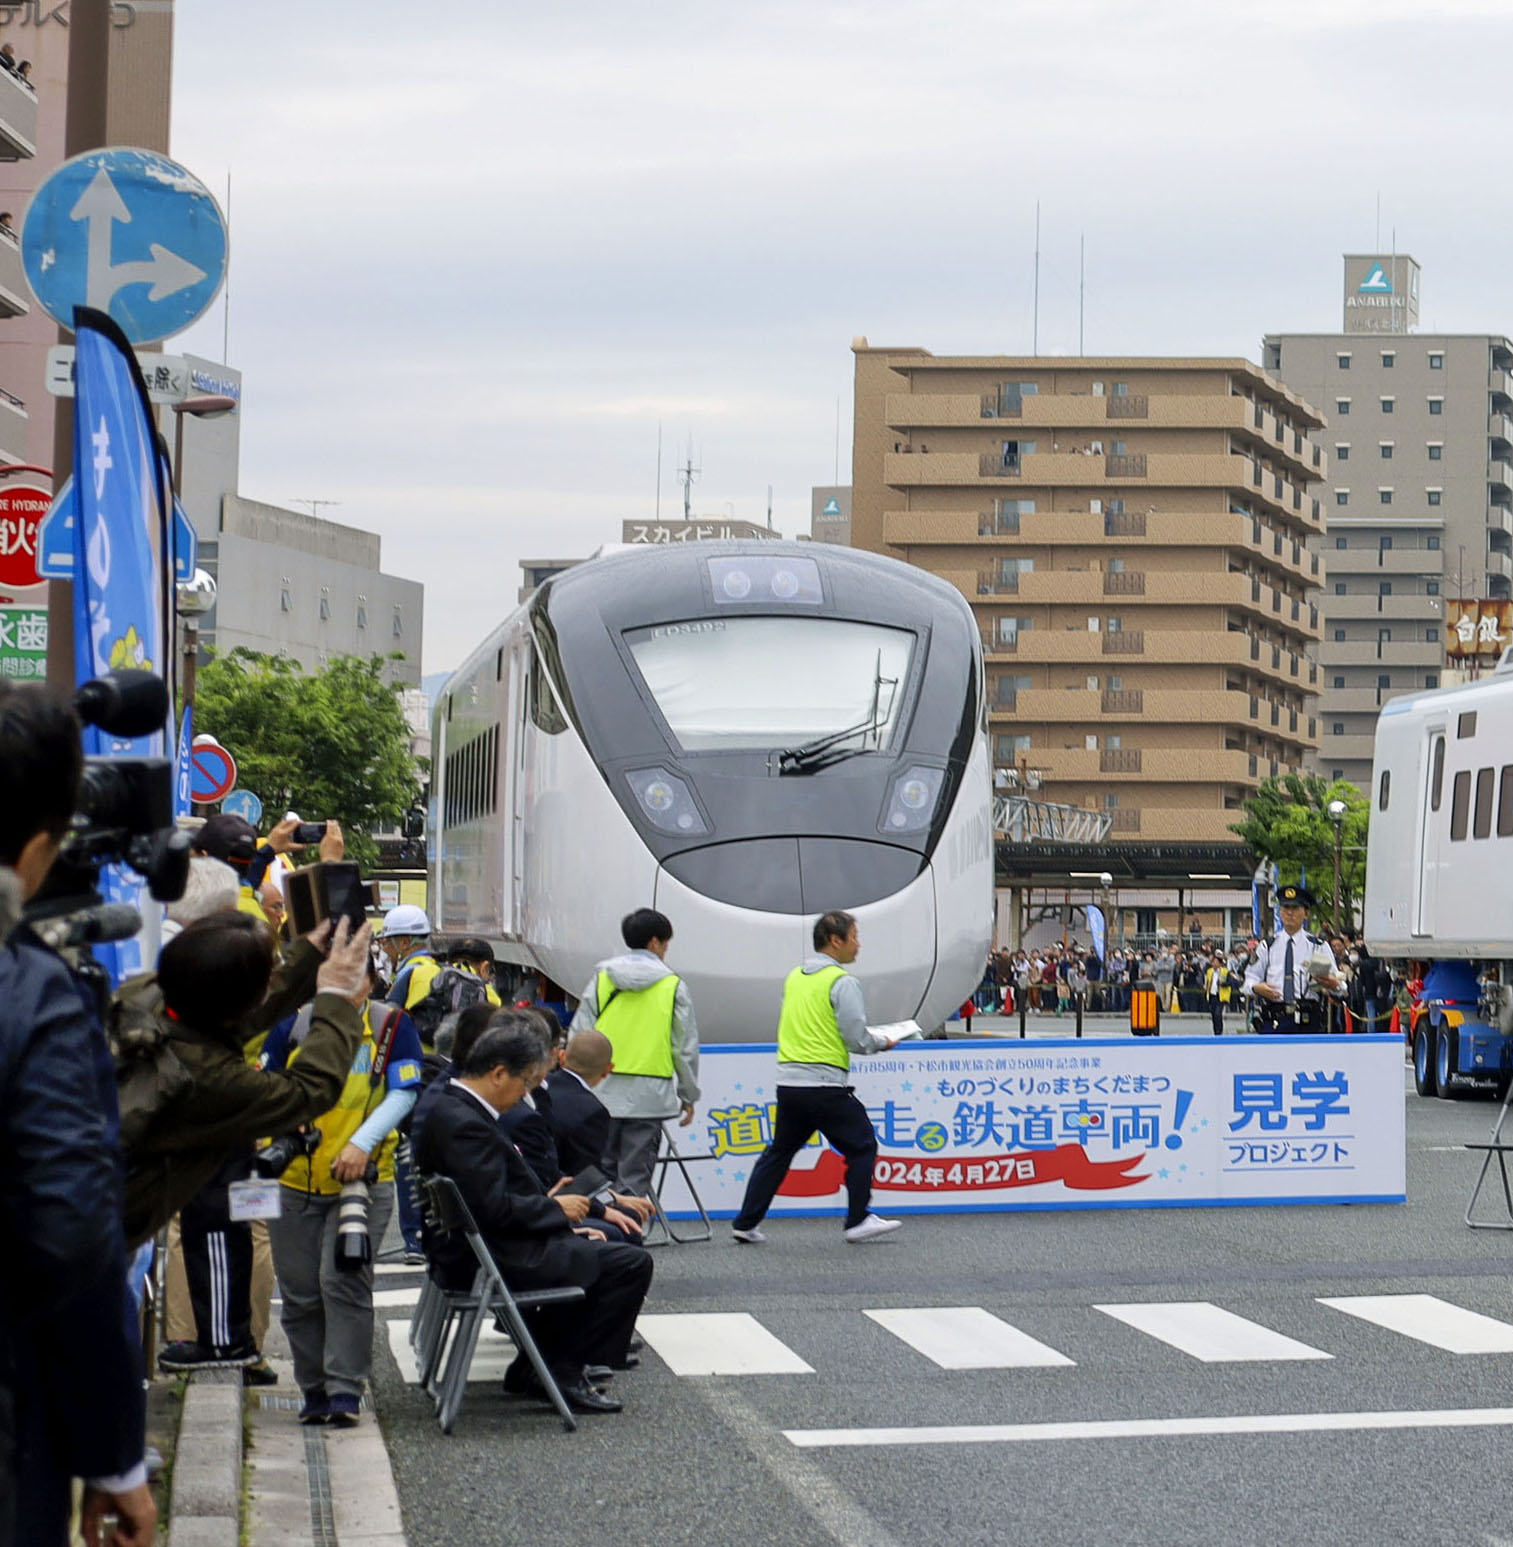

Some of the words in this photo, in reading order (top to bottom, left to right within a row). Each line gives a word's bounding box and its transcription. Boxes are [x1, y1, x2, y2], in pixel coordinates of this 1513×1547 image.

[12, 499, 51, 513] HYDRAN
[631, 525, 736, 544] スカイビル
[1454, 613, 1508, 643] 白銀
[936, 1073, 1171, 1098] ものづくりのまちくだまつ
[1228, 1070, 1350, 1132] 見学
[708, 1088, 1195, 1160] 道走る鉄道車両!
[1228, 1141, 1349, 1164] プロジェクト
[872, 1158, 1037, 1187] 024年4月27日
